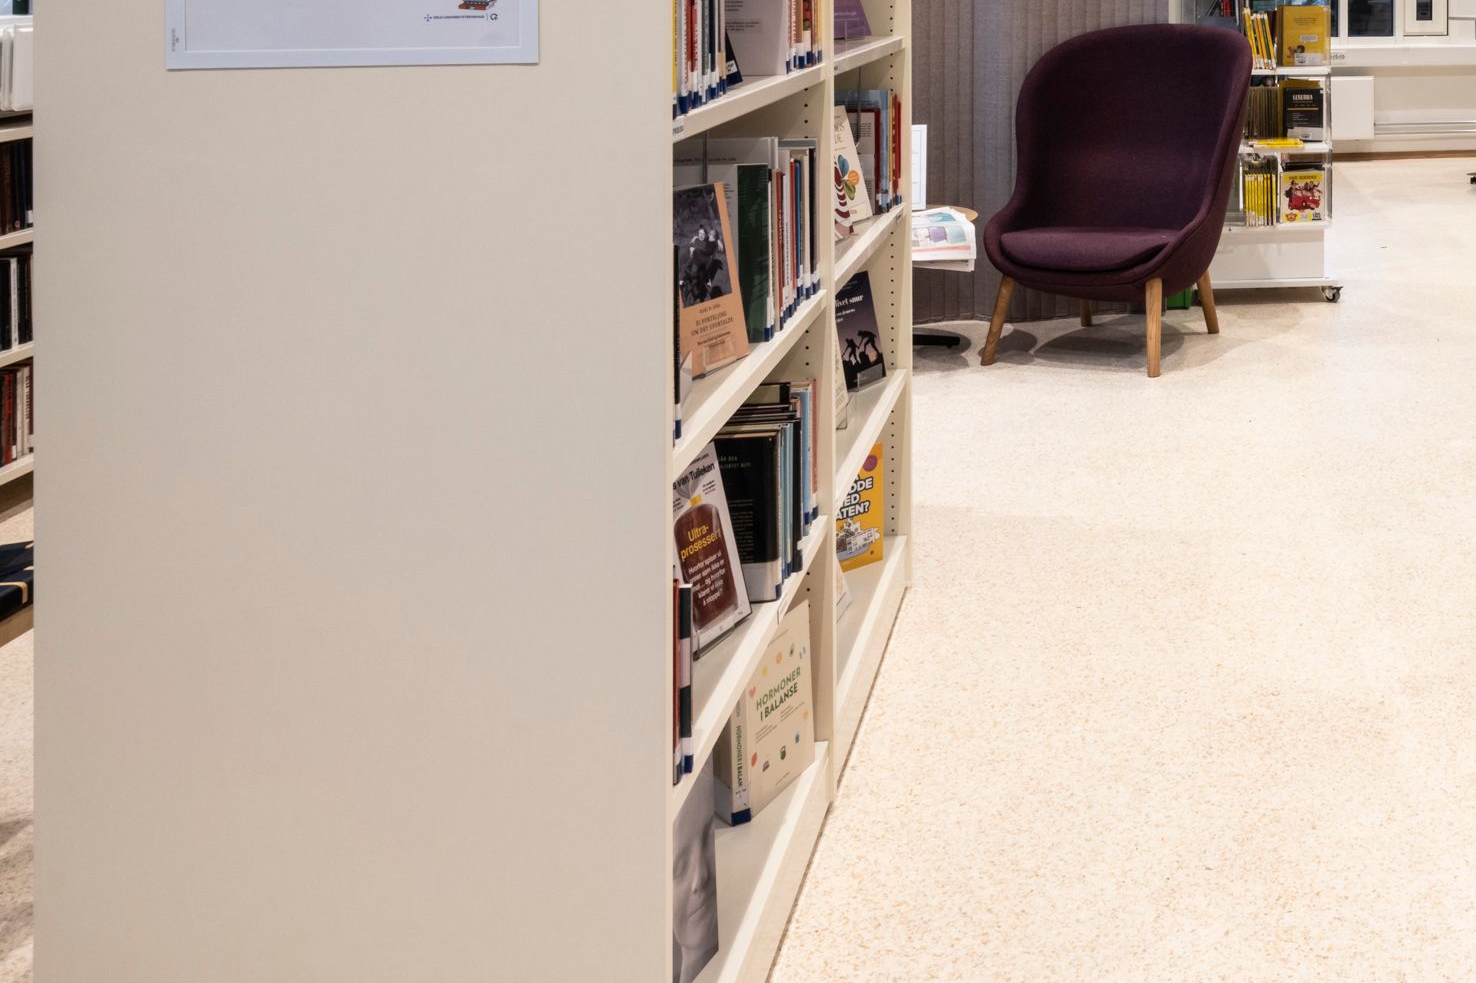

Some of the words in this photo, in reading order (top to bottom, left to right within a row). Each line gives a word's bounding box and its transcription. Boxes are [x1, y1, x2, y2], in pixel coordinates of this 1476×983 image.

[676, 476, 691, 487] van
[848, 476, 874, 494] DDE
[843, 493, 860, 506] ED
[836, 501, 870, 522] ATEN?
[688, 524, 709, 542] Ultra-
[680, 528, 722, 562] prosessert
[755, 665, 802, 711] HORMONER
[764, 682, 798, 718] BALANSE
